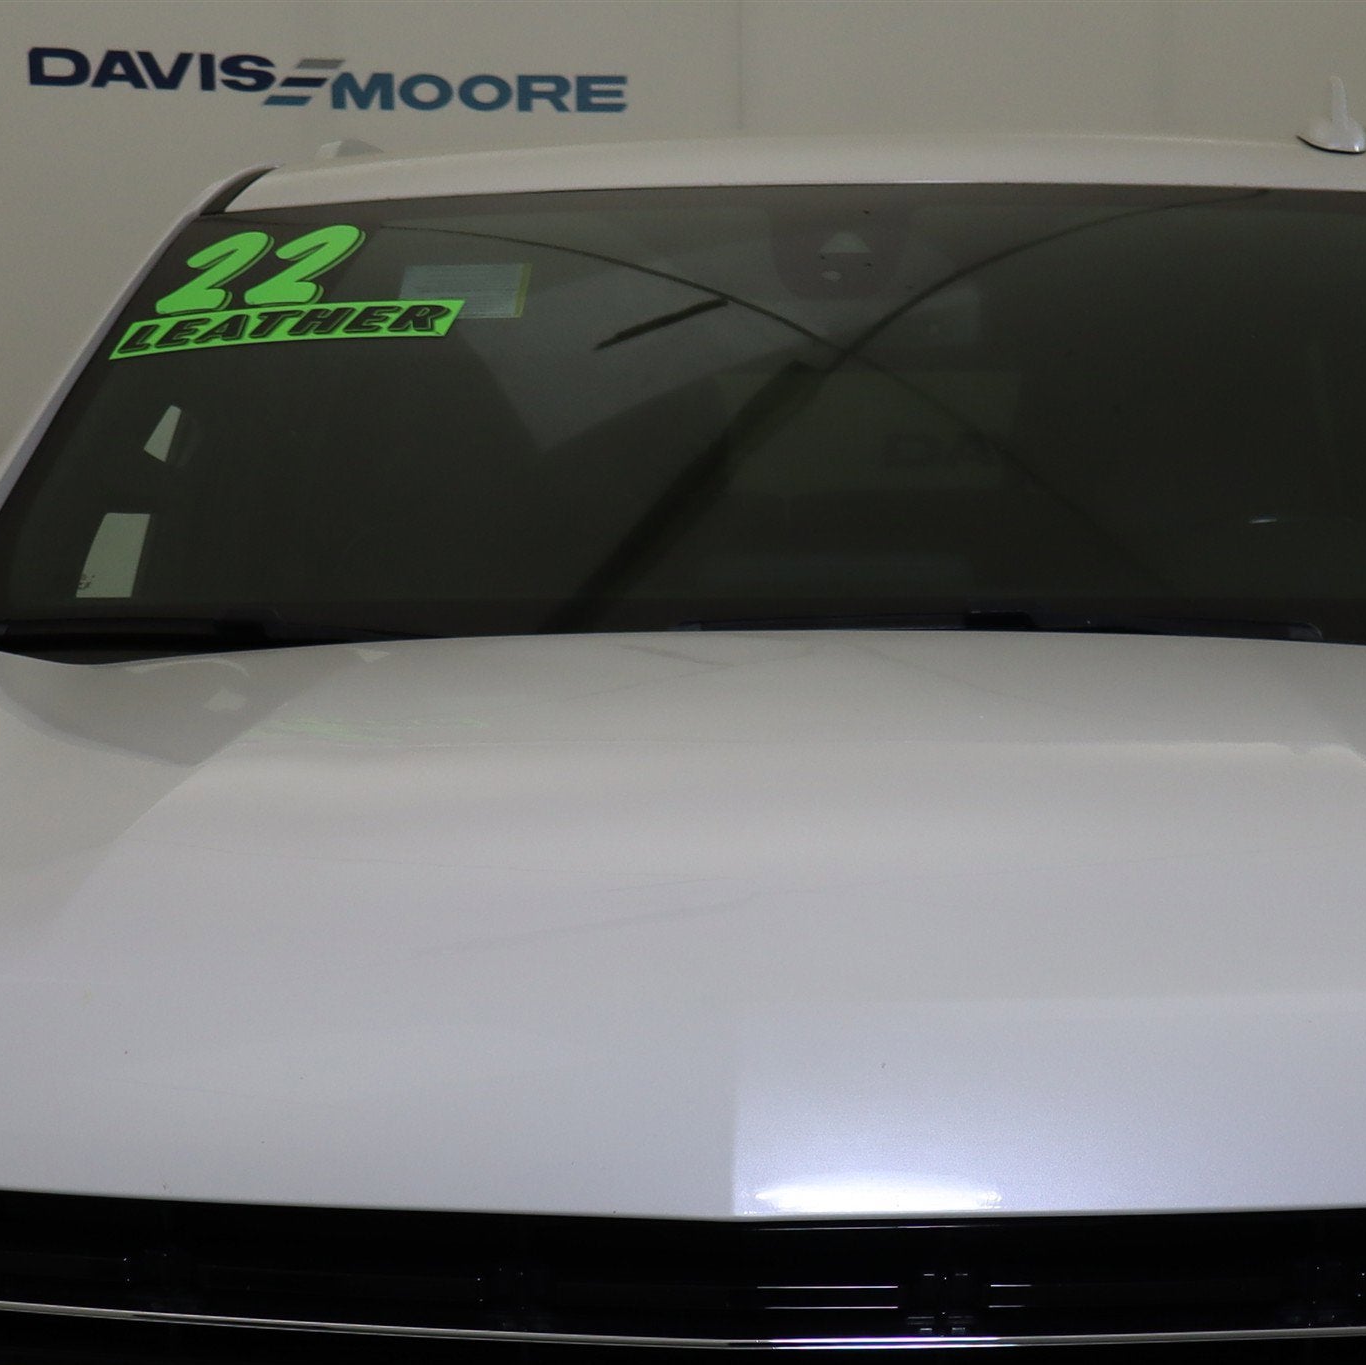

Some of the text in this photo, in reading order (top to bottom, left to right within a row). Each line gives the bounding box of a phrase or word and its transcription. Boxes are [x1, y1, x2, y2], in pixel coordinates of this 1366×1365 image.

[27, 46, 629, 114] DAVIS MOORE
[155, 224, 367, 315] 22
[117, 303, 452, 355] LEATHER
